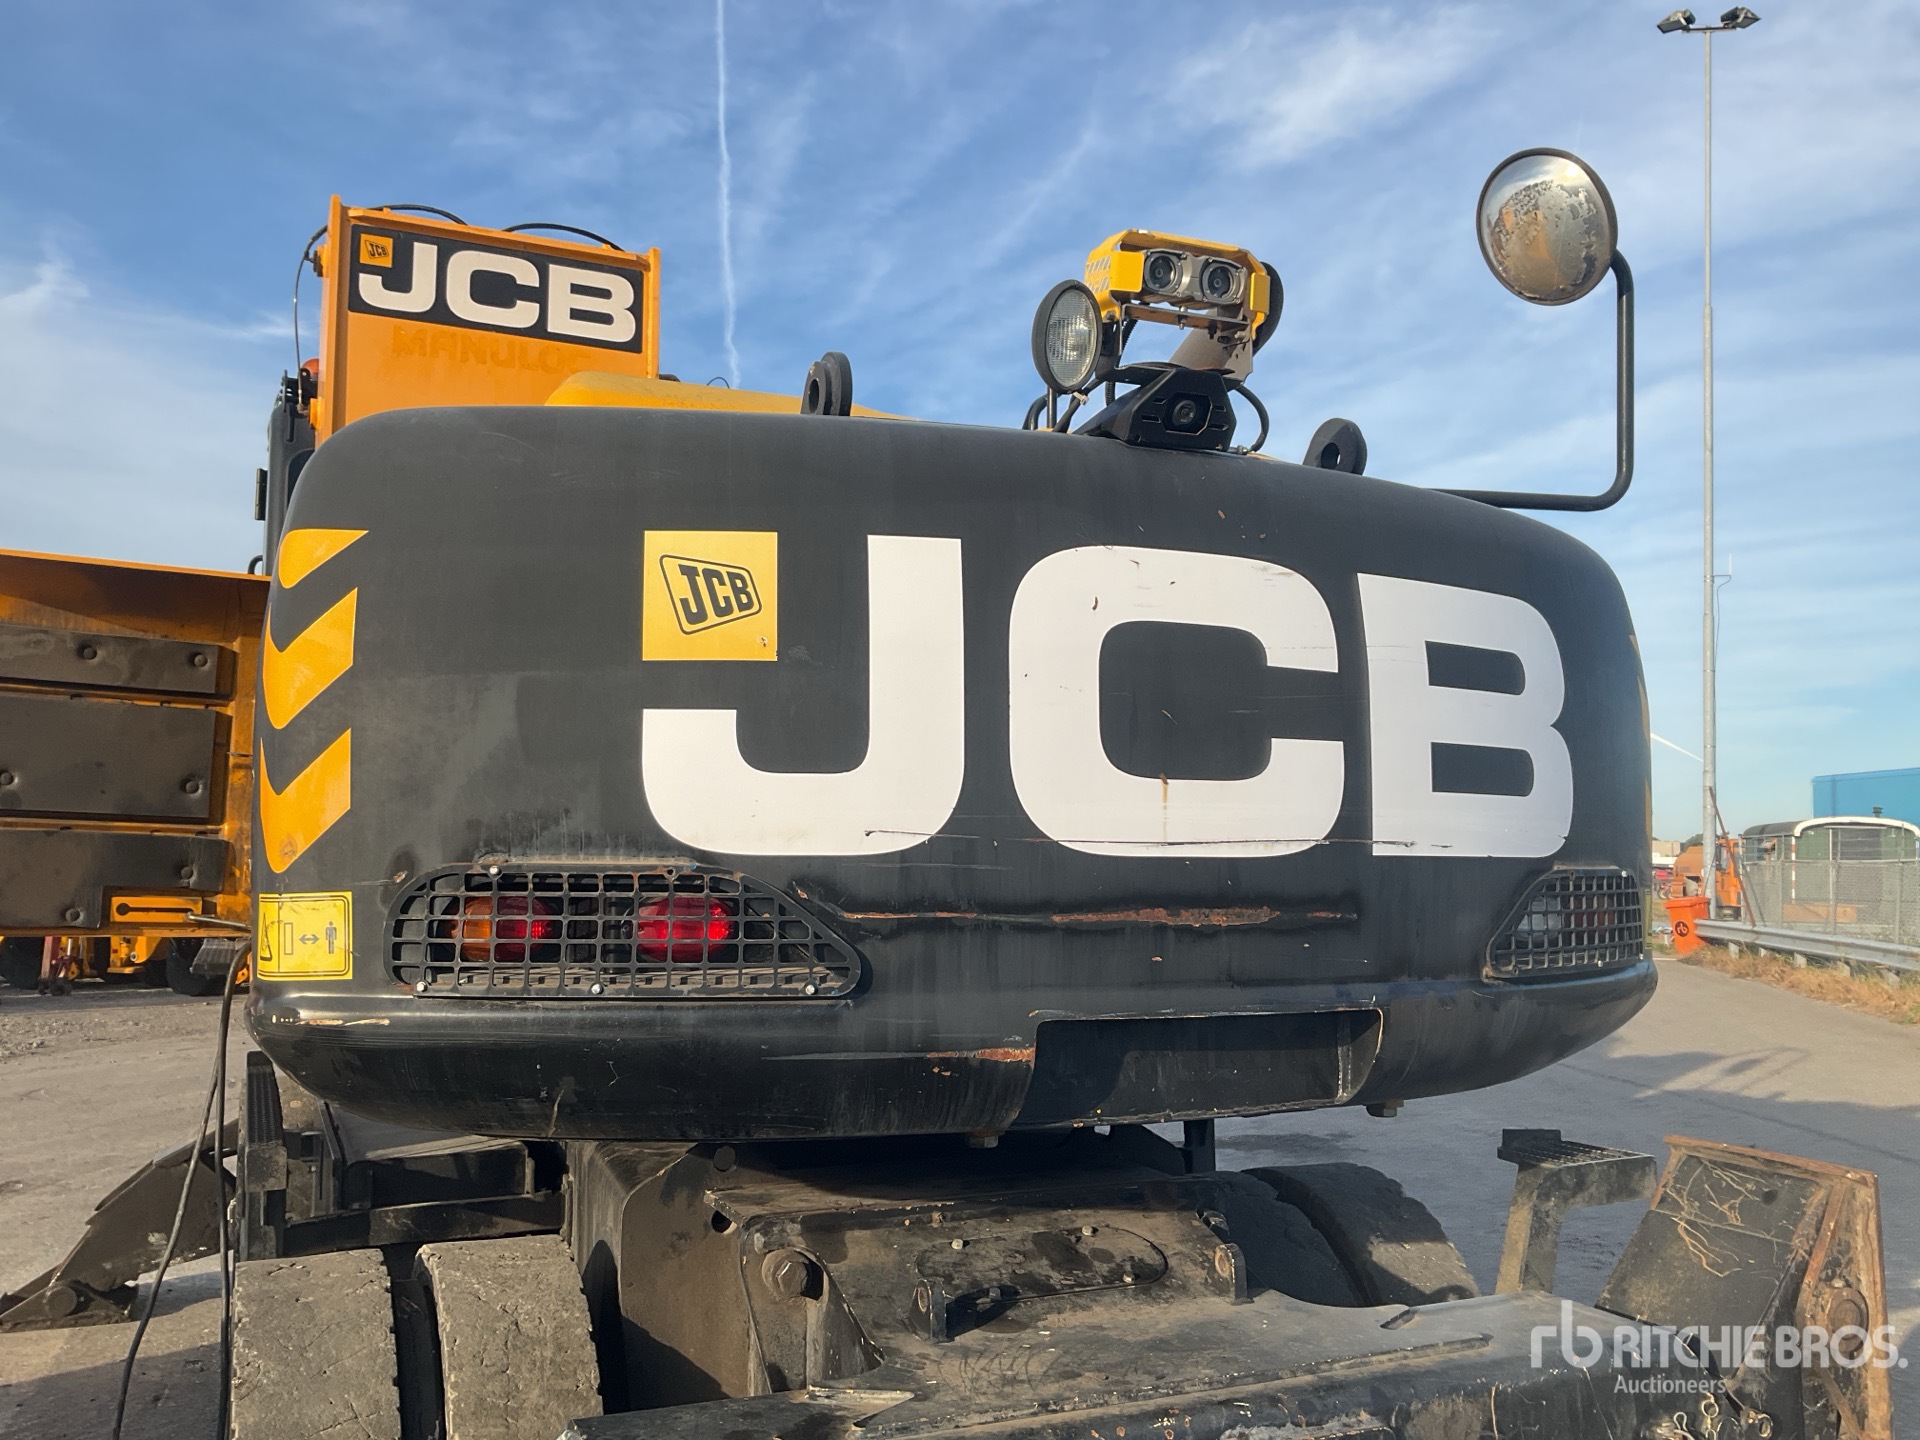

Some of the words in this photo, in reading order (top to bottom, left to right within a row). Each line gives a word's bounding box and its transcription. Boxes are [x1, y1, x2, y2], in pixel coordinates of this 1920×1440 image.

[369, 242, 388, 257] JCB
[358, 241, 636, 343] JCB
[679, 564, 755, 626] JCB
[642, 534, 1574, 857] JCB
